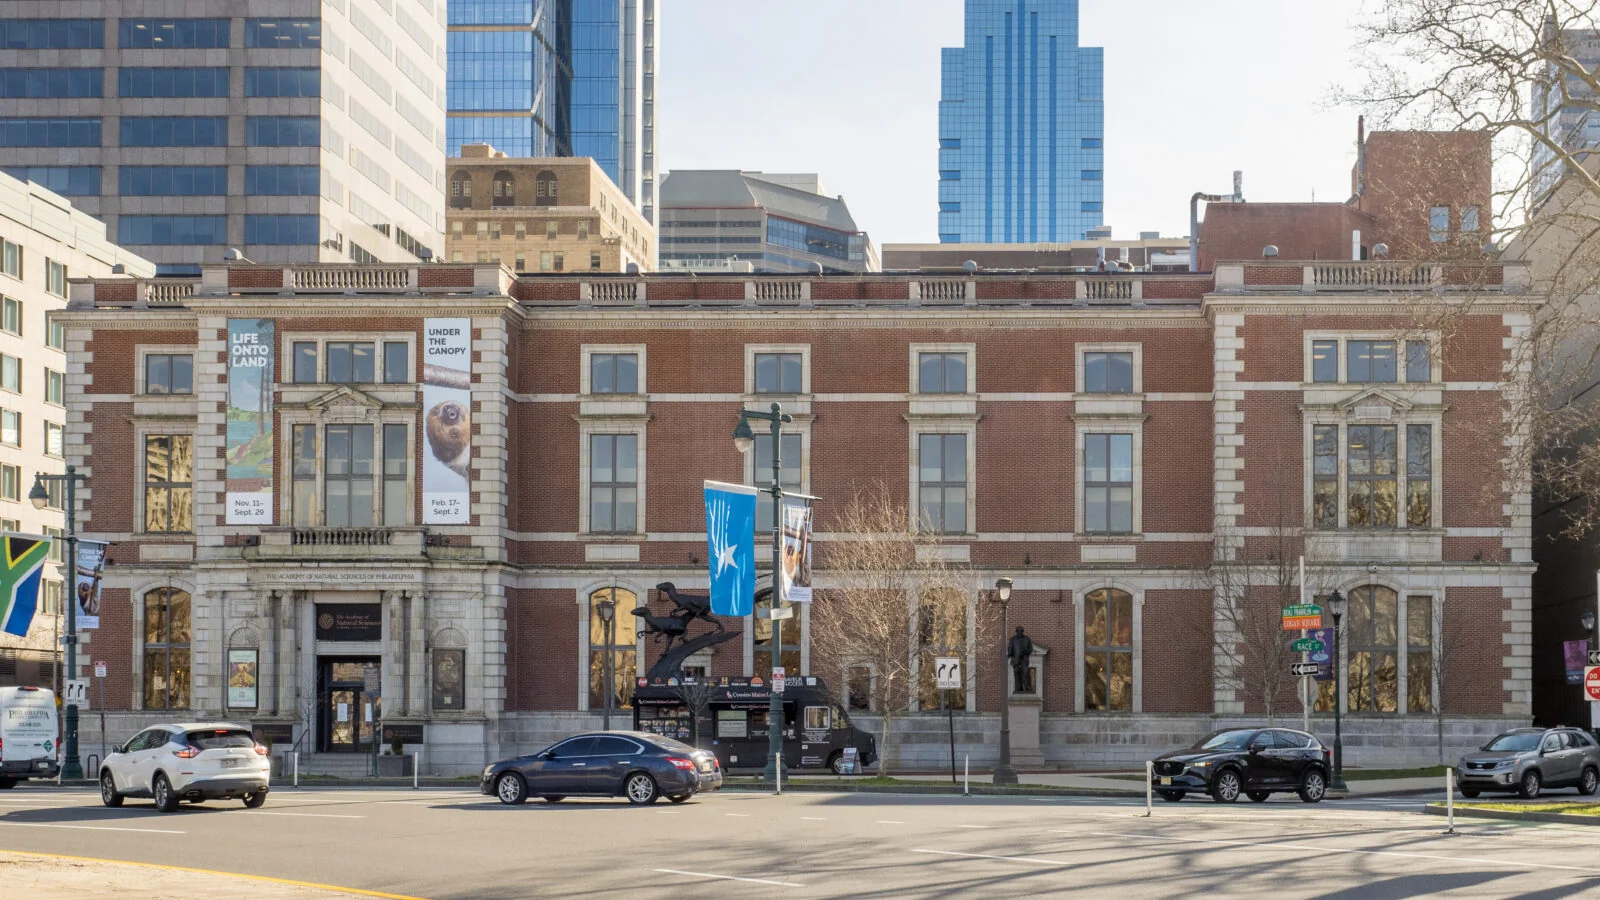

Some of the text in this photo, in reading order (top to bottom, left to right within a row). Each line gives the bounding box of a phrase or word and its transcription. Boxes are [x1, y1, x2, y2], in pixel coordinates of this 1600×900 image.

[428, 328, 460, 336] UNDER
[232, 333, 258, 344] LIFE
[232, 345, 269, 356] ONTO
[428, 347, 466, 355] CANOPY
[232, 356, 267, 367] LAND
[234, 509, 252, 517] Sept.
[1294, 608, 1312, 616] FRANKLIN
[1283, 618, 1320, 628] LOGAN SQUARE
[1297, 643, 1312, 651] RACE
[9, 710, 49, 720] PHILADELPHIA
